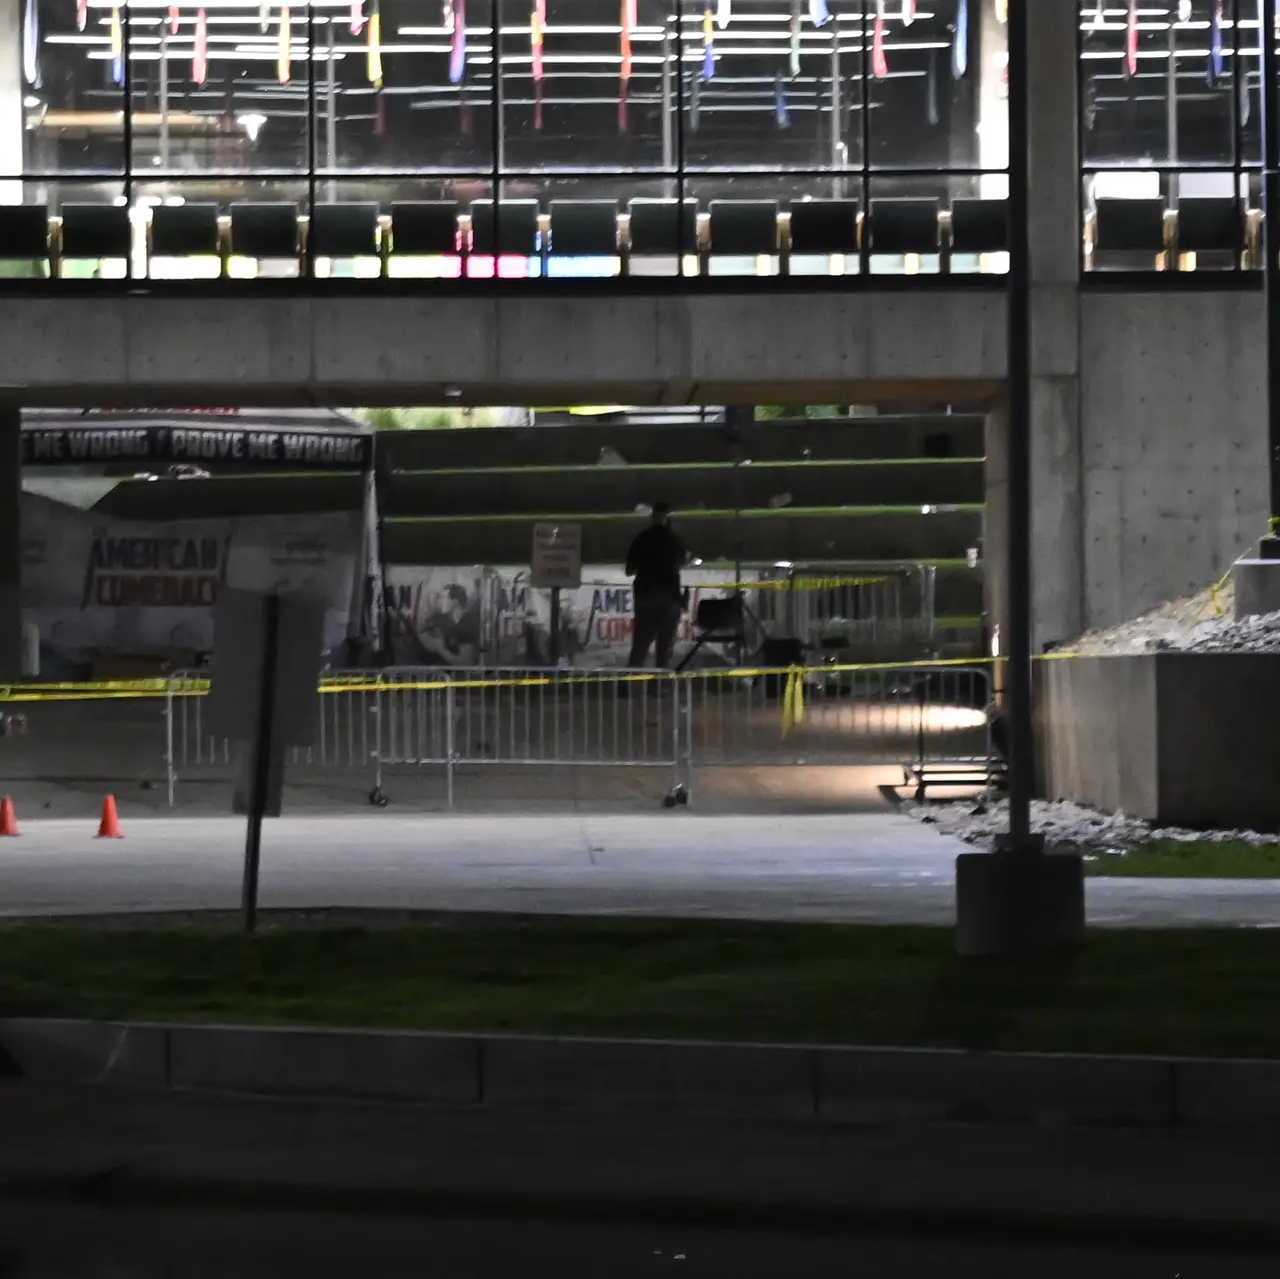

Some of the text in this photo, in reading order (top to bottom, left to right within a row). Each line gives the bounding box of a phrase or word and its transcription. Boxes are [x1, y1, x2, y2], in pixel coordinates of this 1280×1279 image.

[68, 430, 149, 459] WRONG
[172, 430, 245, 459] PROVE
[248, 432, 280, 460] ME
[283, 433, 364, 463] WRONG
[91, 538, 218, 570] AMERICAN
[96, 576, 220, 606] COMEBAC
